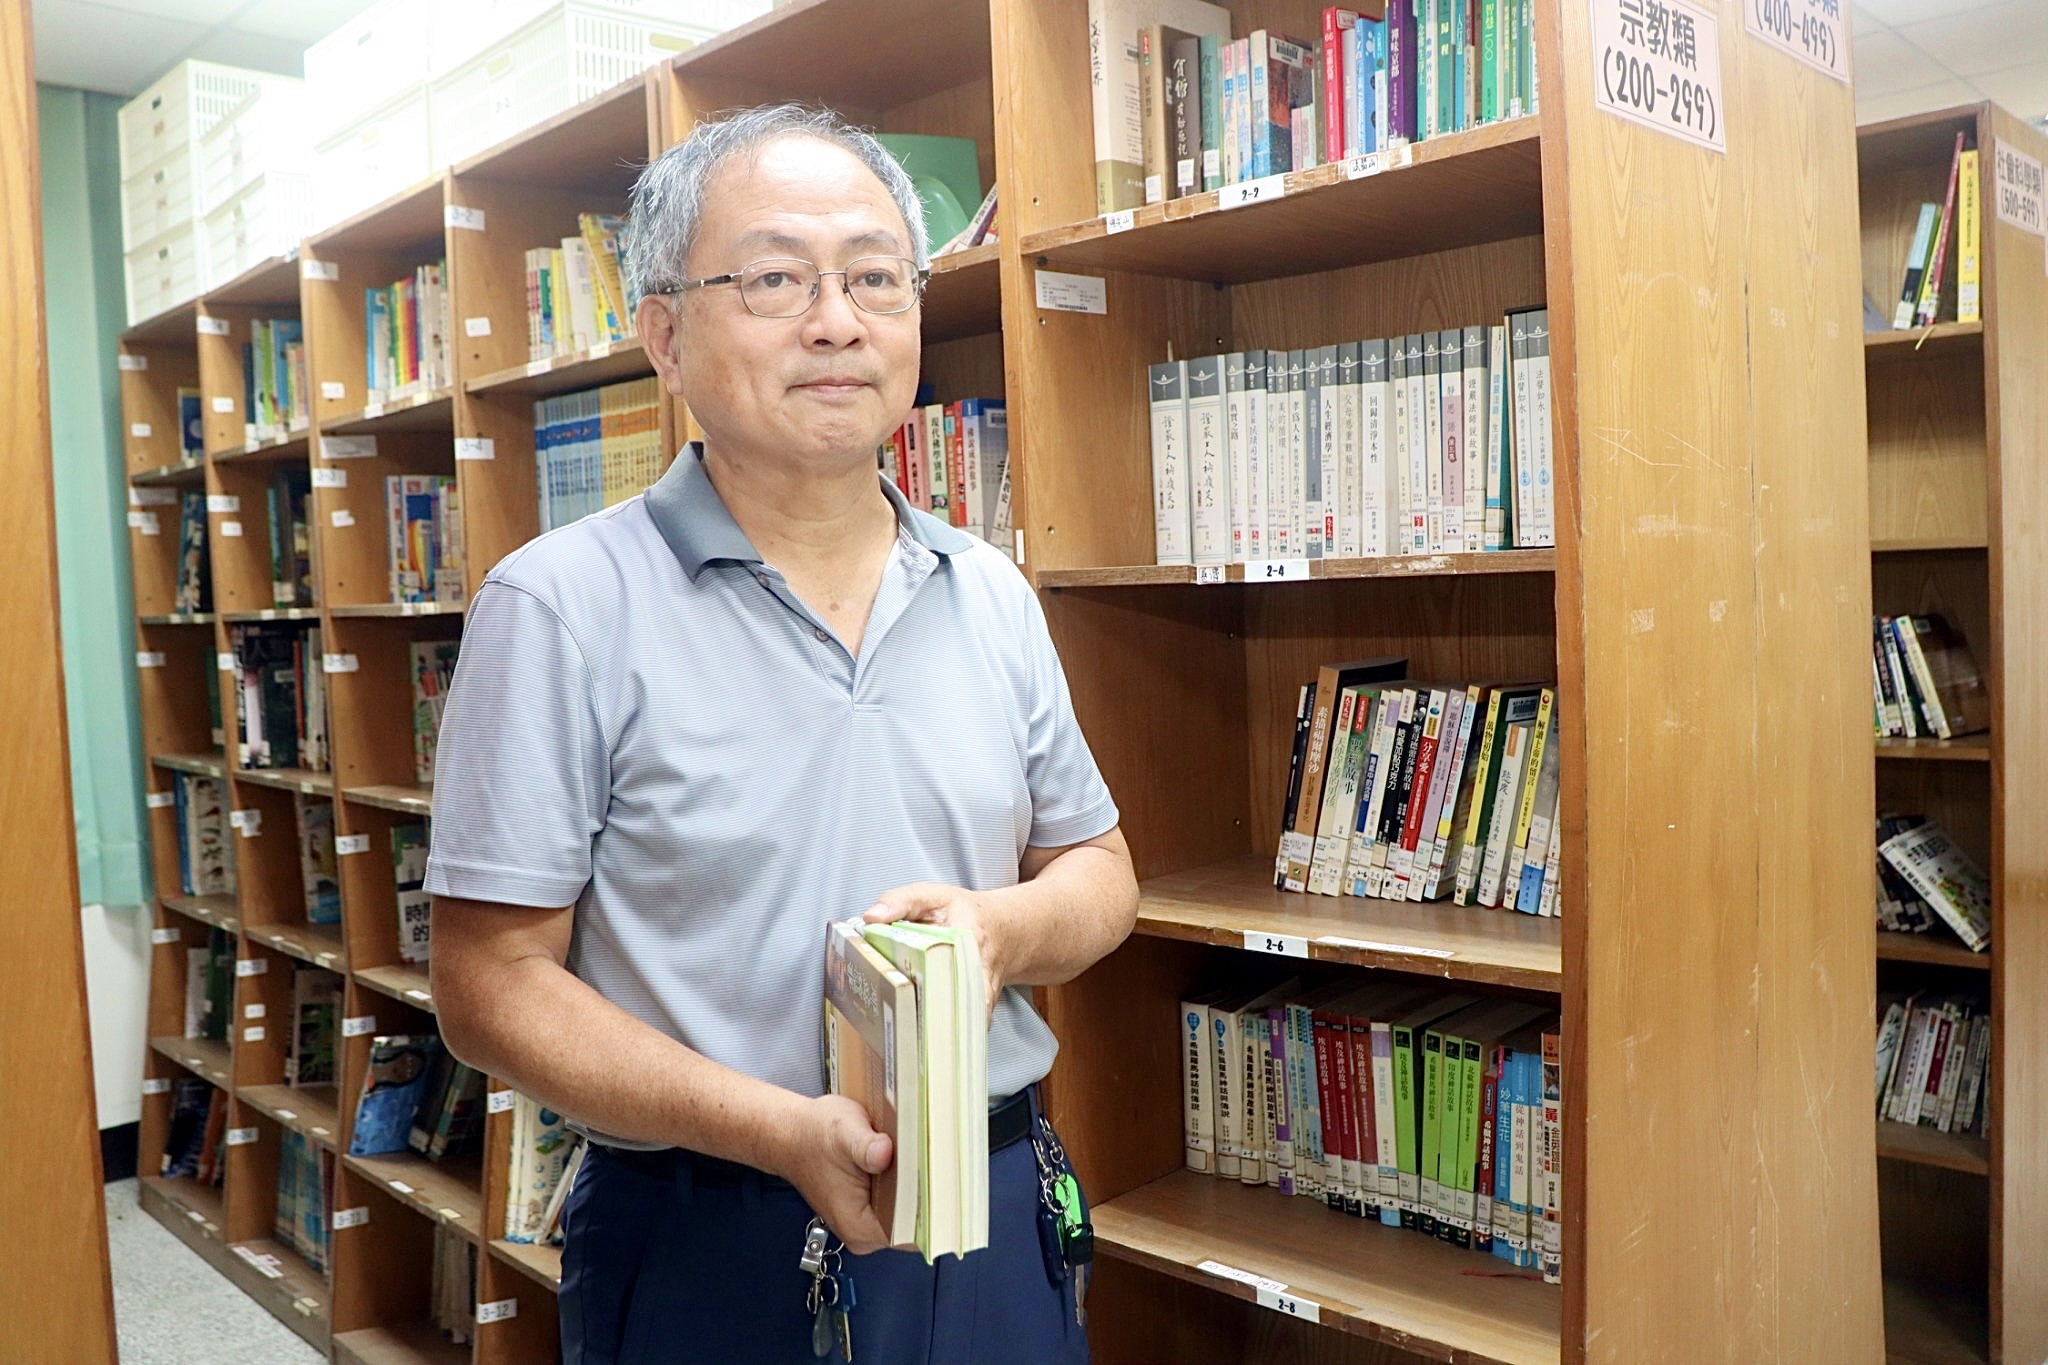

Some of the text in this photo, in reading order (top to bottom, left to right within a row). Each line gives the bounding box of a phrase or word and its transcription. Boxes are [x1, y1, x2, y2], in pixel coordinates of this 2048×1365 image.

[1619, 0, 1697, 72] 宗教類
[1754, 0, 1836, 69] (400-499)
[1603, 46, 1716, 139] (200-299)
[1241, 187, 1259, 201] 2-2
[1998, 150, 2041, 195] 社會科學類
[2001, 186, 2040, 230] (500-599)
[1536, 369, 1546, 411] 法譬如水
[1370, 396, 1378, 464] 回歸清淨本性
[1469, 379, 1478, 461] 證嚴法師說故事
[1267, 565, 1285, 577] 2-4
[1309, 706, 1329, 773] 素描福爾摩沙
[1419, 742, 1433, 774] 分享愛
[1266, 938, 1284, 952] 2-6
[1190, 1042, 1200, 1110] 希臘羅馬神話與傳說
[1218, 1048, 1230, 1118] 希臘羅馬神話與傳說
[1246, 1045, 1254, 1116] 希臘羅馬神話故事
[1318, 1037, 1329, 1086] 埃及神話故事
[1336, 1041, 1347, 1090] 埃及神話故事
[1356, 1044, 1367, 1093] 埃及神話故事
[1400, 1053, 1408, 1100] 埃及神話故事
[1447, 1063, 1456, 1112] 印度神話故事
[1500, 1088, 1511, 1142] 妙筆生花
[1515, 1104, 1524, 1176] 從神話到鬼話
[482, 1304, 509, 1321] 3-12
[1278, 1299, 1295, 1313] 2-8
